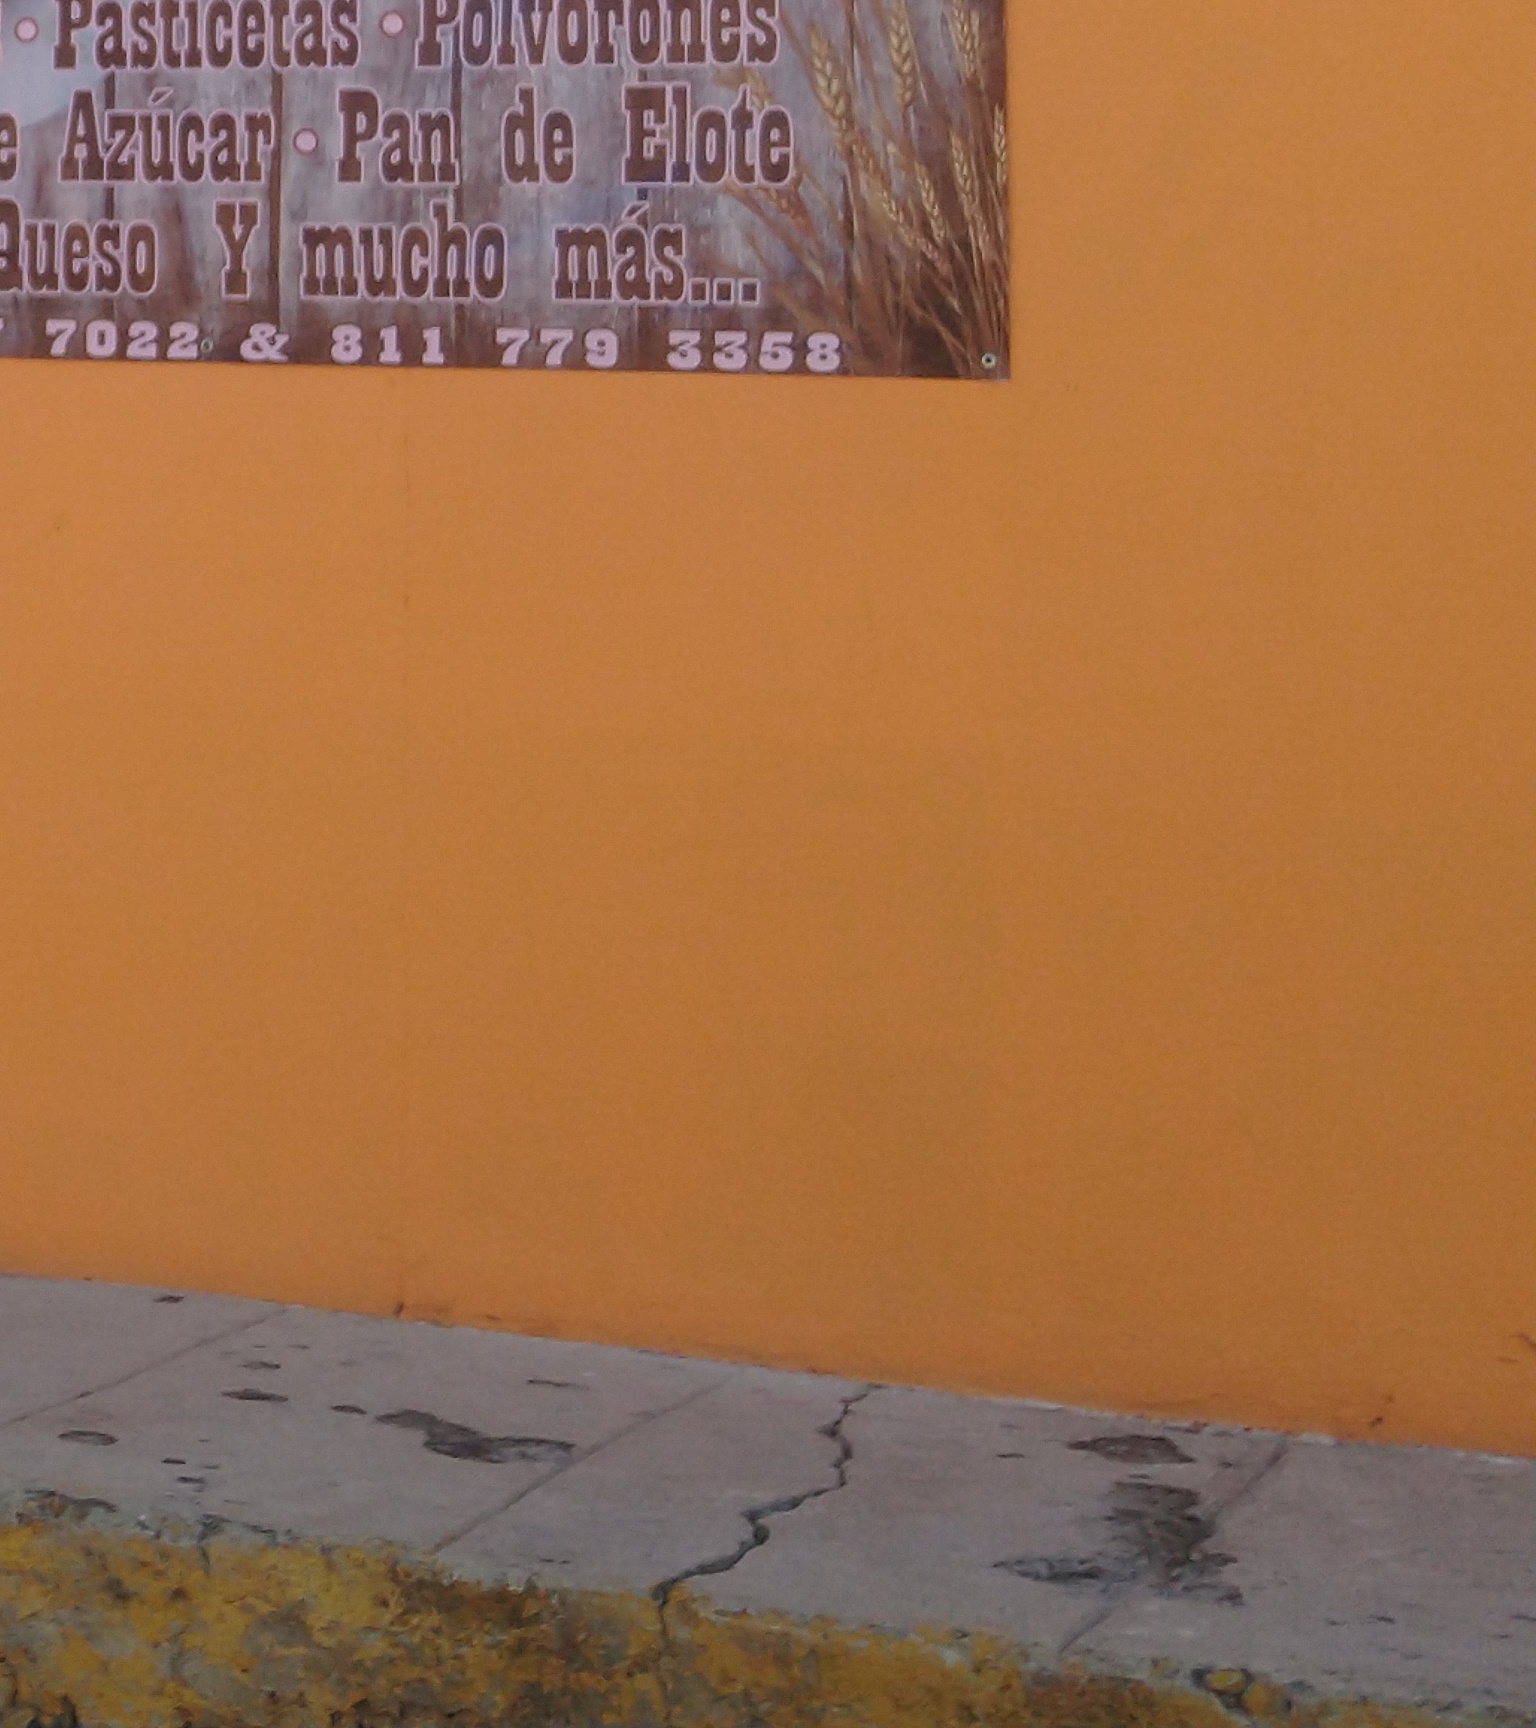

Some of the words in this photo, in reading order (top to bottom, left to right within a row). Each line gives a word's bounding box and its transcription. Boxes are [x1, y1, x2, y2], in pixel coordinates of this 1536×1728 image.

[59, 86, 275, 184] Azúcar
[335, 85, 460, 186] Pan
[501, 83, 575, 185] de
[621, 82, 794, 186] Elote
[214, 198, 260, 300] Y
[300, 198, 507, 302] mucho
[552, 201, 760, 306] más...
[46, 319, 200, 360] 7022
[239, 323, 290, 362] &
[331, 324, 445, 365] 811
[495, 327, 619, 368] 779
[666, 328, 842, 371] 3358
